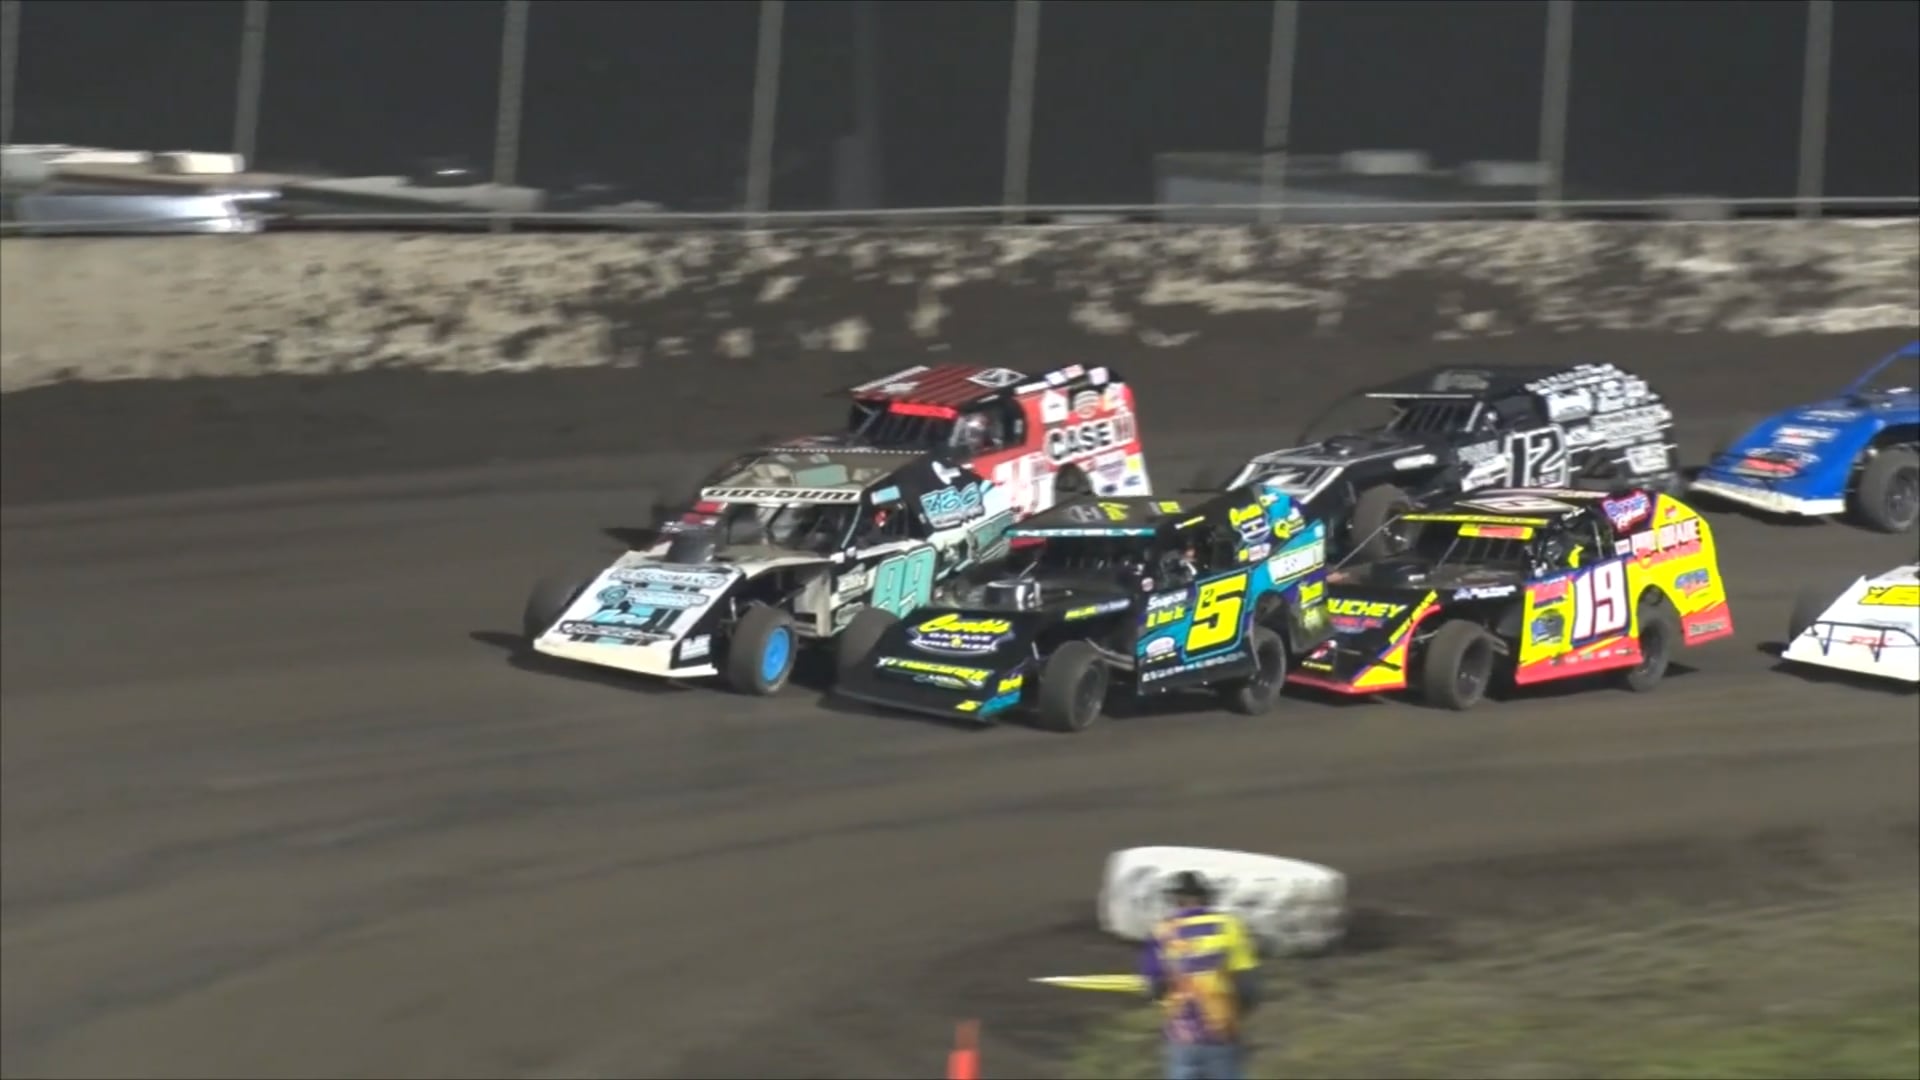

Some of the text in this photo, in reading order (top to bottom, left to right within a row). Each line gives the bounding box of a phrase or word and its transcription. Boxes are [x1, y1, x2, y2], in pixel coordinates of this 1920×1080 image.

[1047, 421, 1111, 464] CASE
[1505, 425, 1564, 488] 12
[872, 545, 936, 619] 99
[1186, 572, 1247, 652] 5
[1573, 558, 1628, 641] 19
